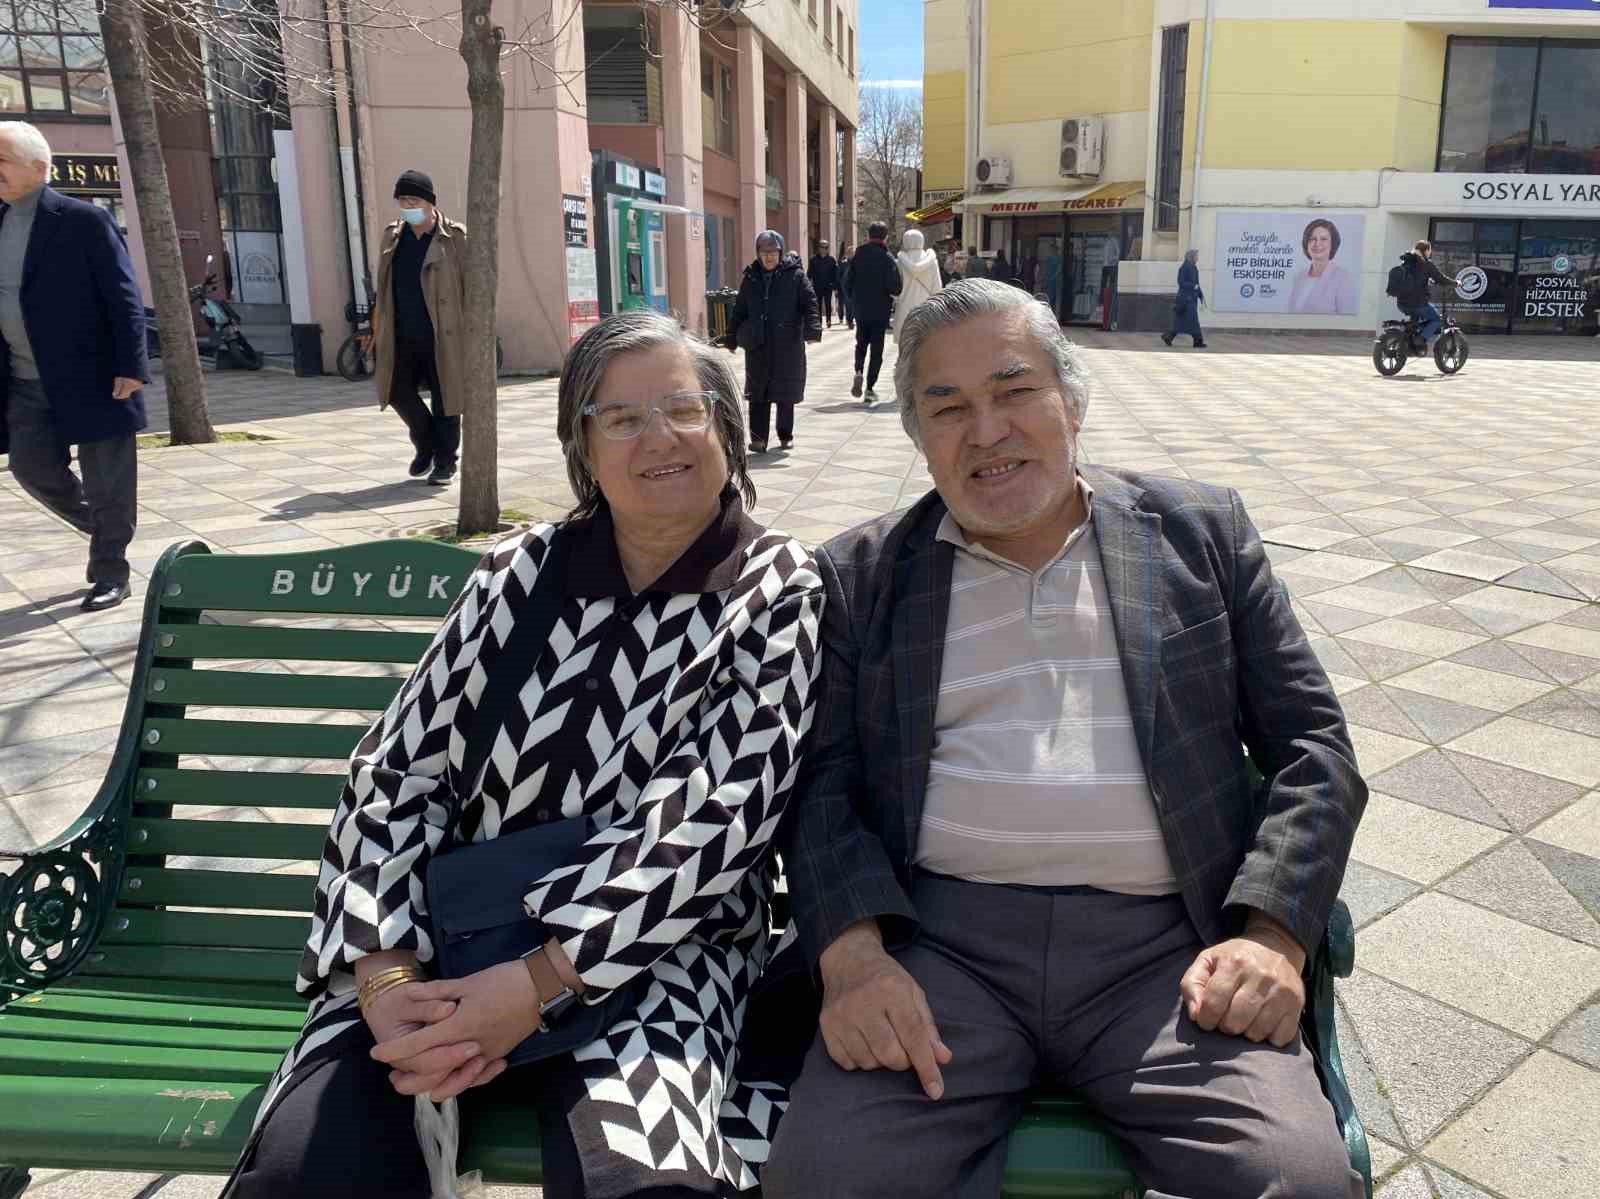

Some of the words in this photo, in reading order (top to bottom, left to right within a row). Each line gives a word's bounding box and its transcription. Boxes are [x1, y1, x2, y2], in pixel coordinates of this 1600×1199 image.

[67, 159, 86, 185] İŞ
[1463, 182, 1553, 201] SOSYAL
[1559, 183, 1600, 201] YAR
[1227, 257, 1248, 268] HEP
[1250, 256, 1294, 268] BİRLİKLE
[1233, 269, 1285, 280] ESKİŞEHİR
[1535, 277, 1580, 288] SOSYAL
[1526, 288, 1588, 300] HİZMETLER
[1524, 302, 1585, 317] DESTEK
[270, 563, 451, 600] BÜYÜK
